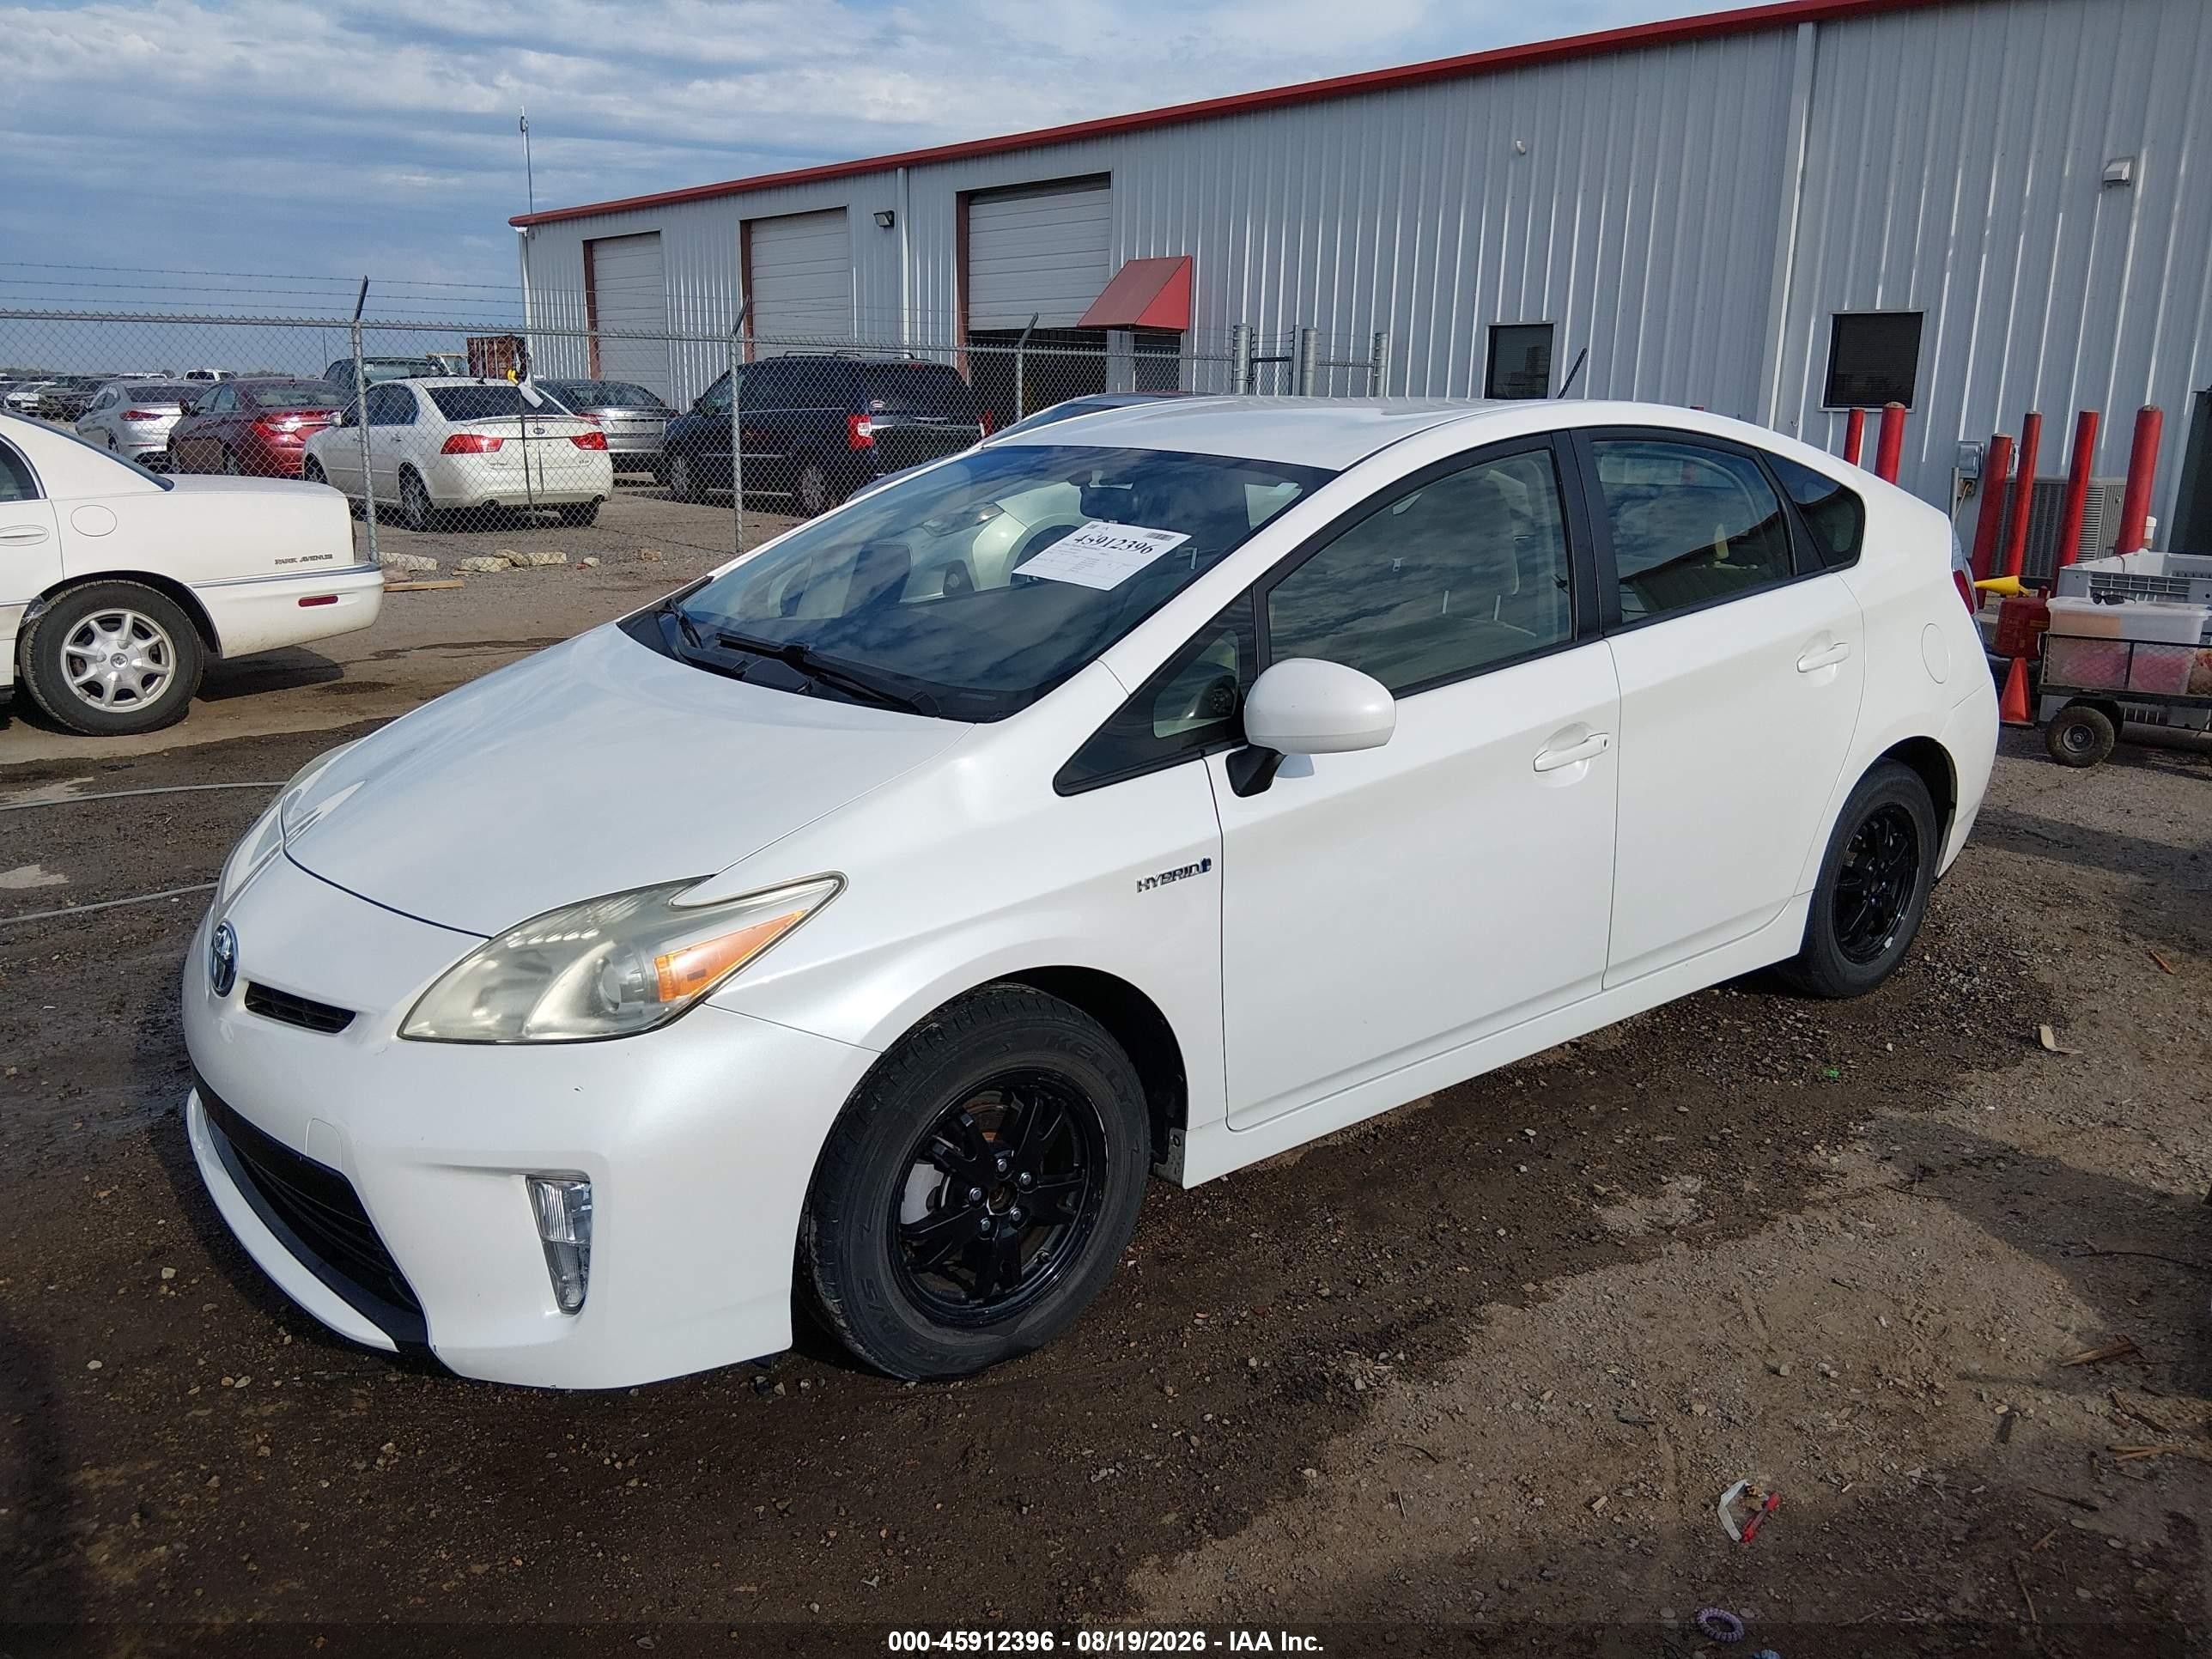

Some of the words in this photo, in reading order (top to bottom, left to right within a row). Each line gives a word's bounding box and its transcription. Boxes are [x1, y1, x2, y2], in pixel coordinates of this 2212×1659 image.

[1074, 533, 1161, 555] 45912396
[1136, 864, 1200, 893] HYBRID
[1044, 1035, 1133, 1106] KELLY
